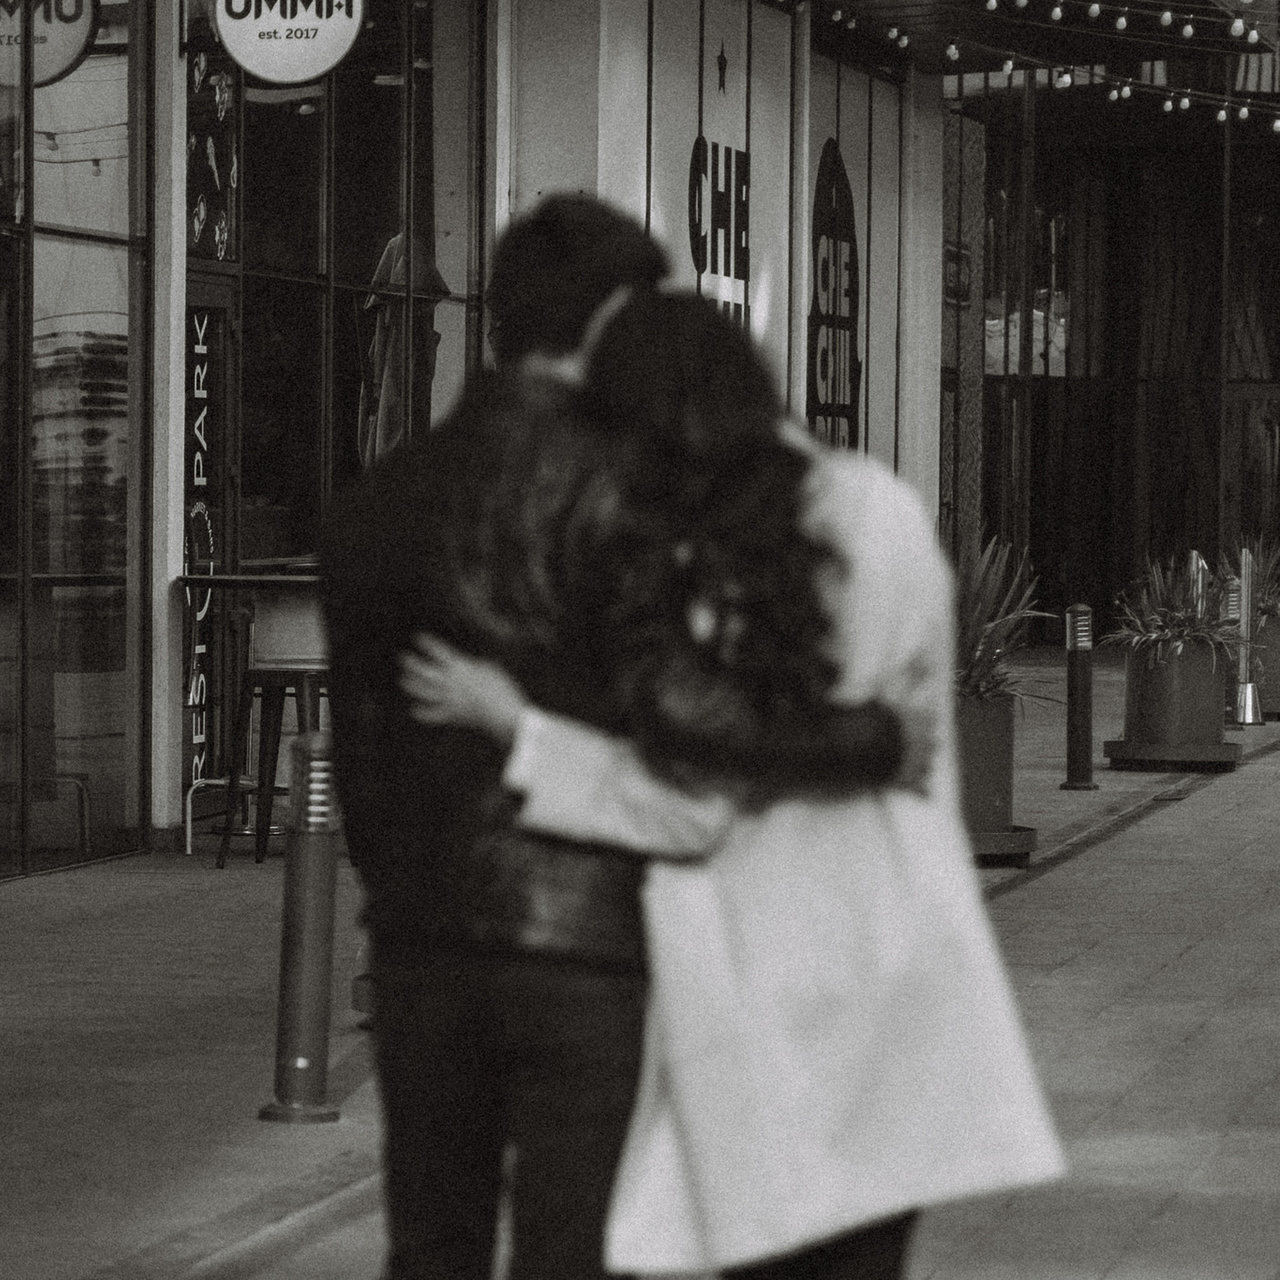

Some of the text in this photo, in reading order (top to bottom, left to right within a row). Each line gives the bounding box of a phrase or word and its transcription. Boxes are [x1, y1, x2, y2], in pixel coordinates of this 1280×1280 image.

[258, 27, 319, 41] est. 2017
[688, 135, 750, 281] CHE
[193, 314, 208, 486] PARK
